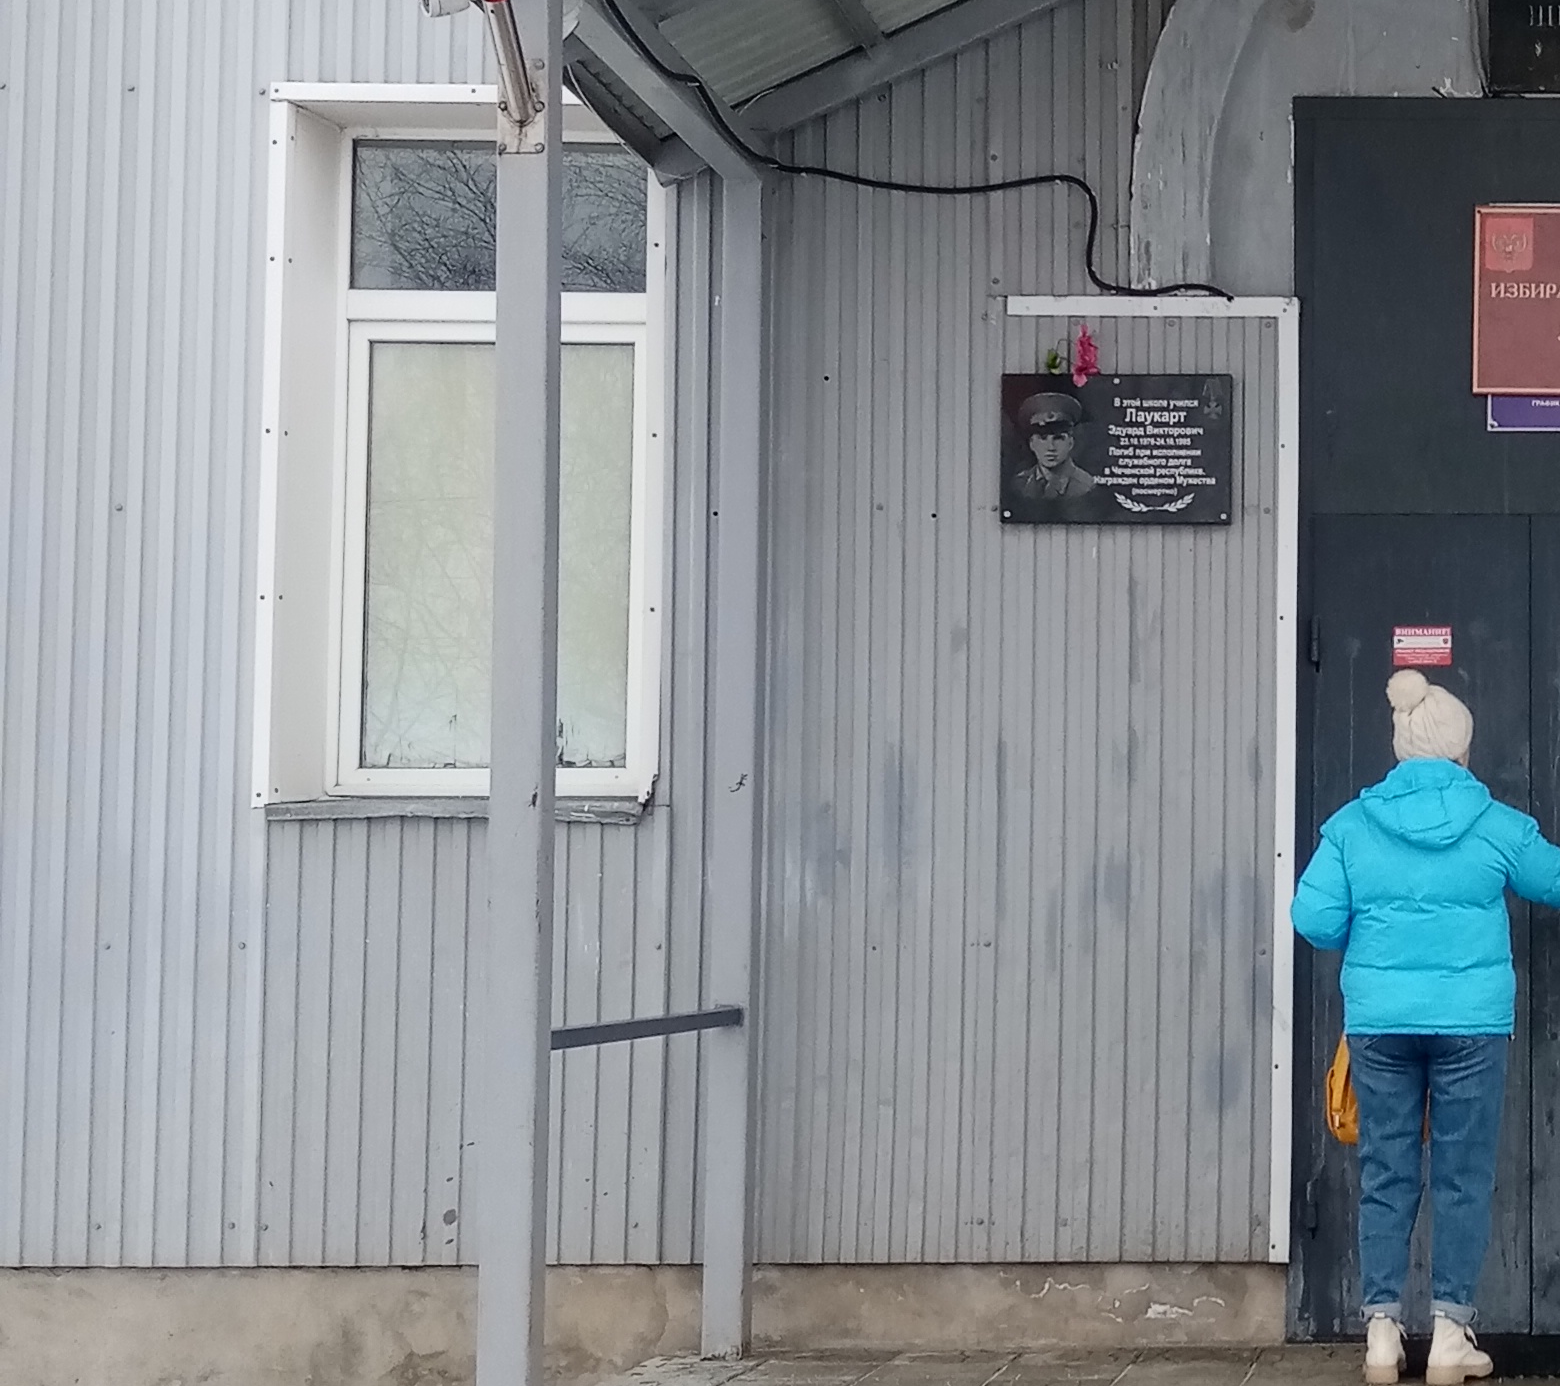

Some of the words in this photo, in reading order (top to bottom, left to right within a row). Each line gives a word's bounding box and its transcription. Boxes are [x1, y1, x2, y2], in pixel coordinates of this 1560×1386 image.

[1113, 397, 1121, 407] В
[1125, 408, 1187, 425] Лаукарт
[1108, 425, 1144, 436] Эдуард
[1146, 425, 1204, 437] Викторович
